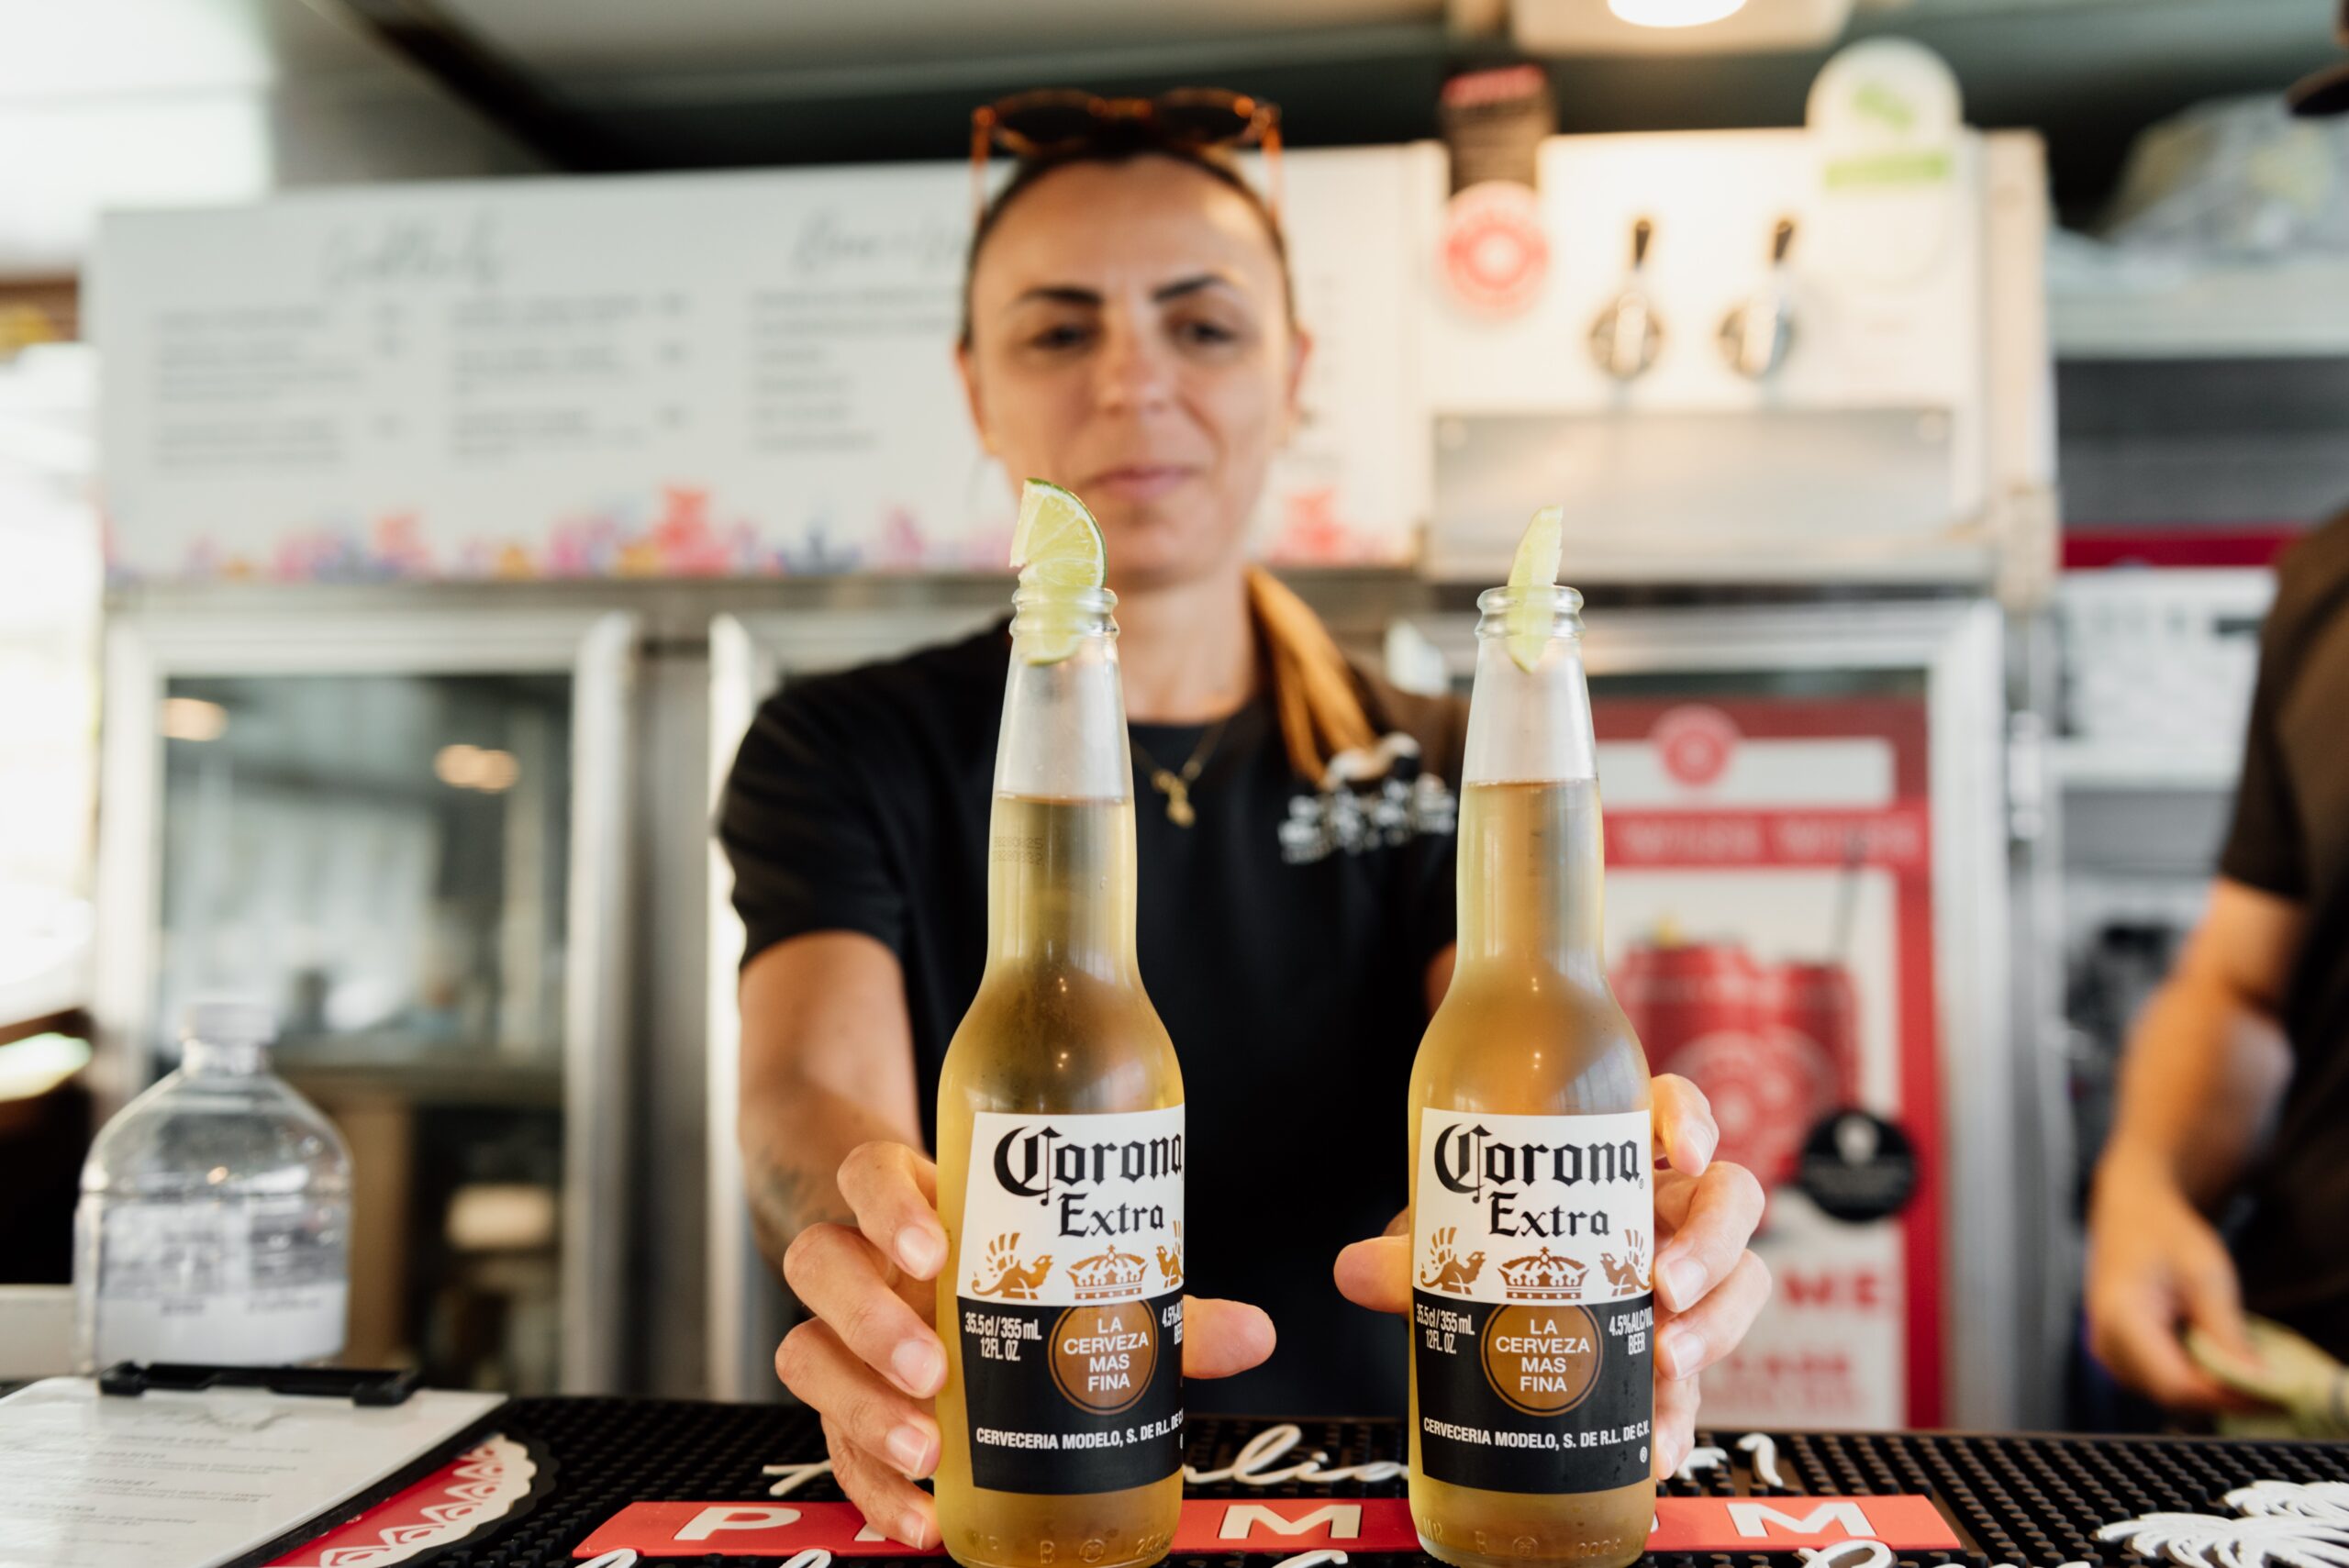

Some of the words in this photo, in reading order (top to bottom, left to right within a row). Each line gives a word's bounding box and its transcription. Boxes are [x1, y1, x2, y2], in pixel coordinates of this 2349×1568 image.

[994, 1126, 1183, 1207] Corona
[1434, 1123, 1641, 1204] Corona
[1057, 1193, 1165, 1238] Extra
[1488, 1191, 1610, 1238] Extra
[1097, 1317, 1123, 1334] LA
[1530, 1319, 1558, 1335] LA
[1063, 1331, 1149, 1355] CERVEZA
[1495, 1336, 1590, 1354] CERVEZA
[1628, 1331, 1646, 1355] BEER
[1089, 1353, 1130, 1373] MAS
[1521, 1357, 1567, 1373] MAS
[1088, 1373, 1130, 1392] FINA
[1520, 1376, 1568, 1393] FINA
[976, 1427, 1059, 1450] CERVECERIA
[1062, 1429, 1124, 1450] MODELO,
[1126, 1428, 1138, 1443] S.
[1141, 1423, 1154, 1441] DE
[1423, 1418, 1492, 1446] CERVECERIA
[1495, 1431, 1559, 1451] MODELO,
[1563, 1433, 1576, 1448] S.
[1580, 1432, 1598, 1448] DE
[1600, 1429, 1621, 1446] R.L.
[1623, 1424, 1636, 1441] DE
